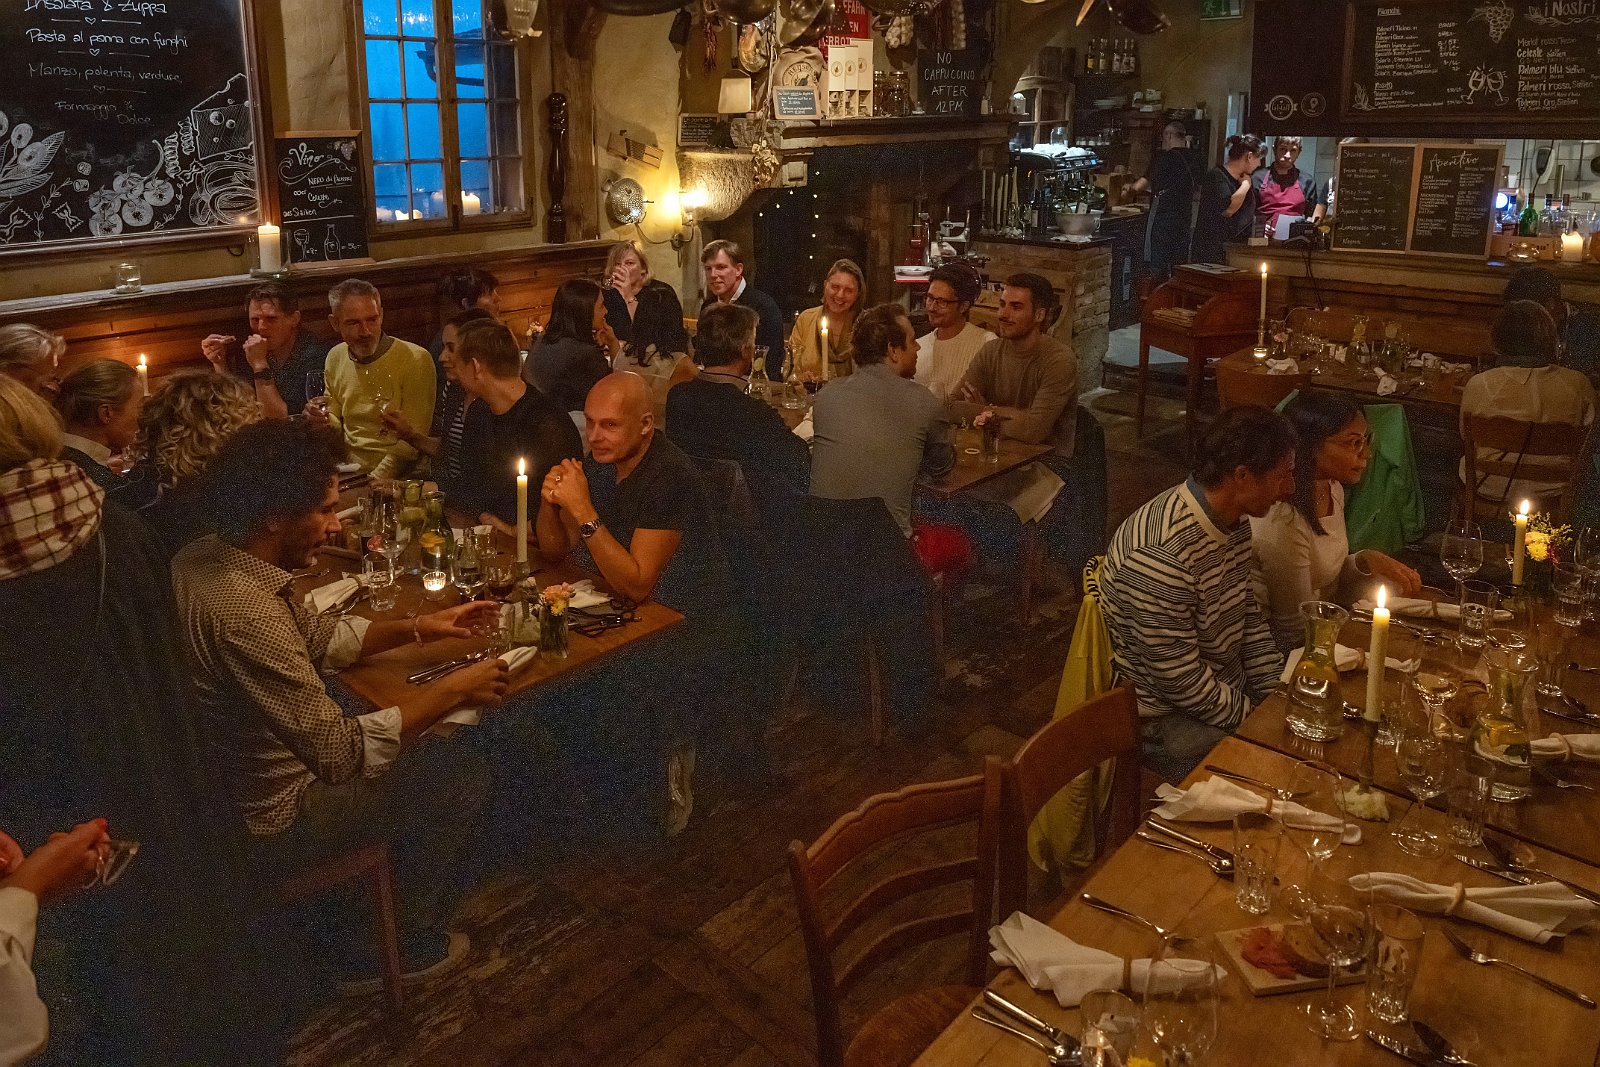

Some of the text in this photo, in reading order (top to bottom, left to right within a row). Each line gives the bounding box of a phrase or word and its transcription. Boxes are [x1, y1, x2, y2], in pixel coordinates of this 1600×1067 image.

[25, 28, 67, 43] Pasta
[73, 31, 84, 43] al
[129, 36, 150, 46] con
[153, 31, 189, 55] funghi
[937, 52, 952, 64] NO
[29, 62, 81, 80] Manzo,
[84, 66, 135, 81] polenta,
[924, 67, 975, 80] CAPPUCCINO
[1518, 65, 1547, 75] Palmeri
[931, 85, 968, 97] AFTER
[289, 142, 324, 168] Vino
